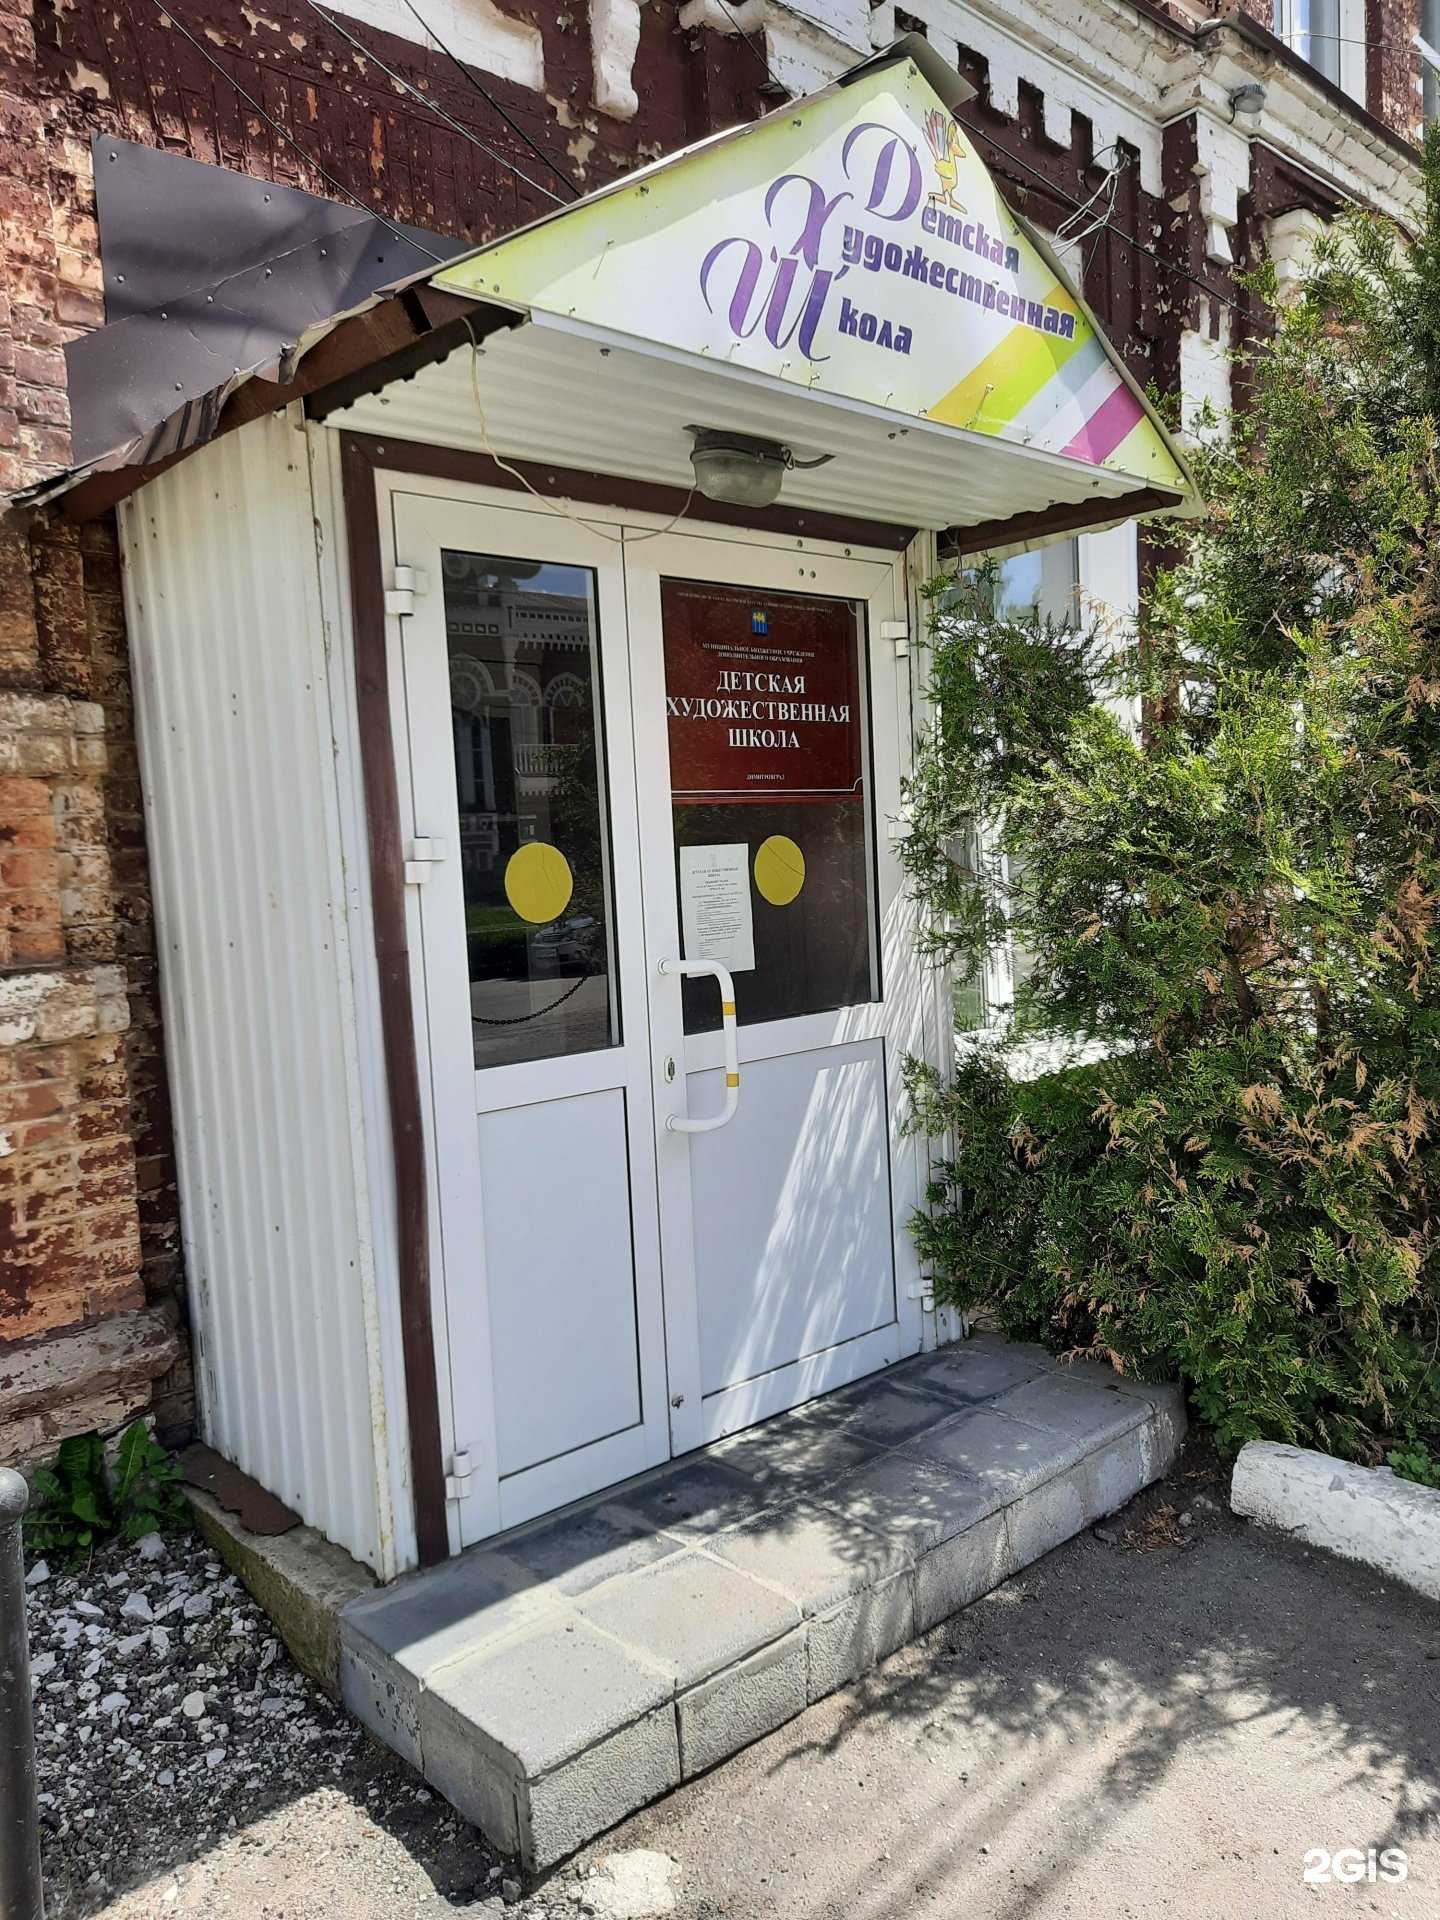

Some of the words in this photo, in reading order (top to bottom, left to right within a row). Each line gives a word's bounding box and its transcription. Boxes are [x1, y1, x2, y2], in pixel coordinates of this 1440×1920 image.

[842, 122, 1020, 274] Детская
[764, 174, 1076, 340] Художественная
[699, 237, 914, 363] Школа
[666, 696, 851, 723] ХУДОЖЕСТВЕННАЯ
[716, 670, 806, 694] ДЕТСКАЯ
[728, 728, 800, 748] ШКОЛА
